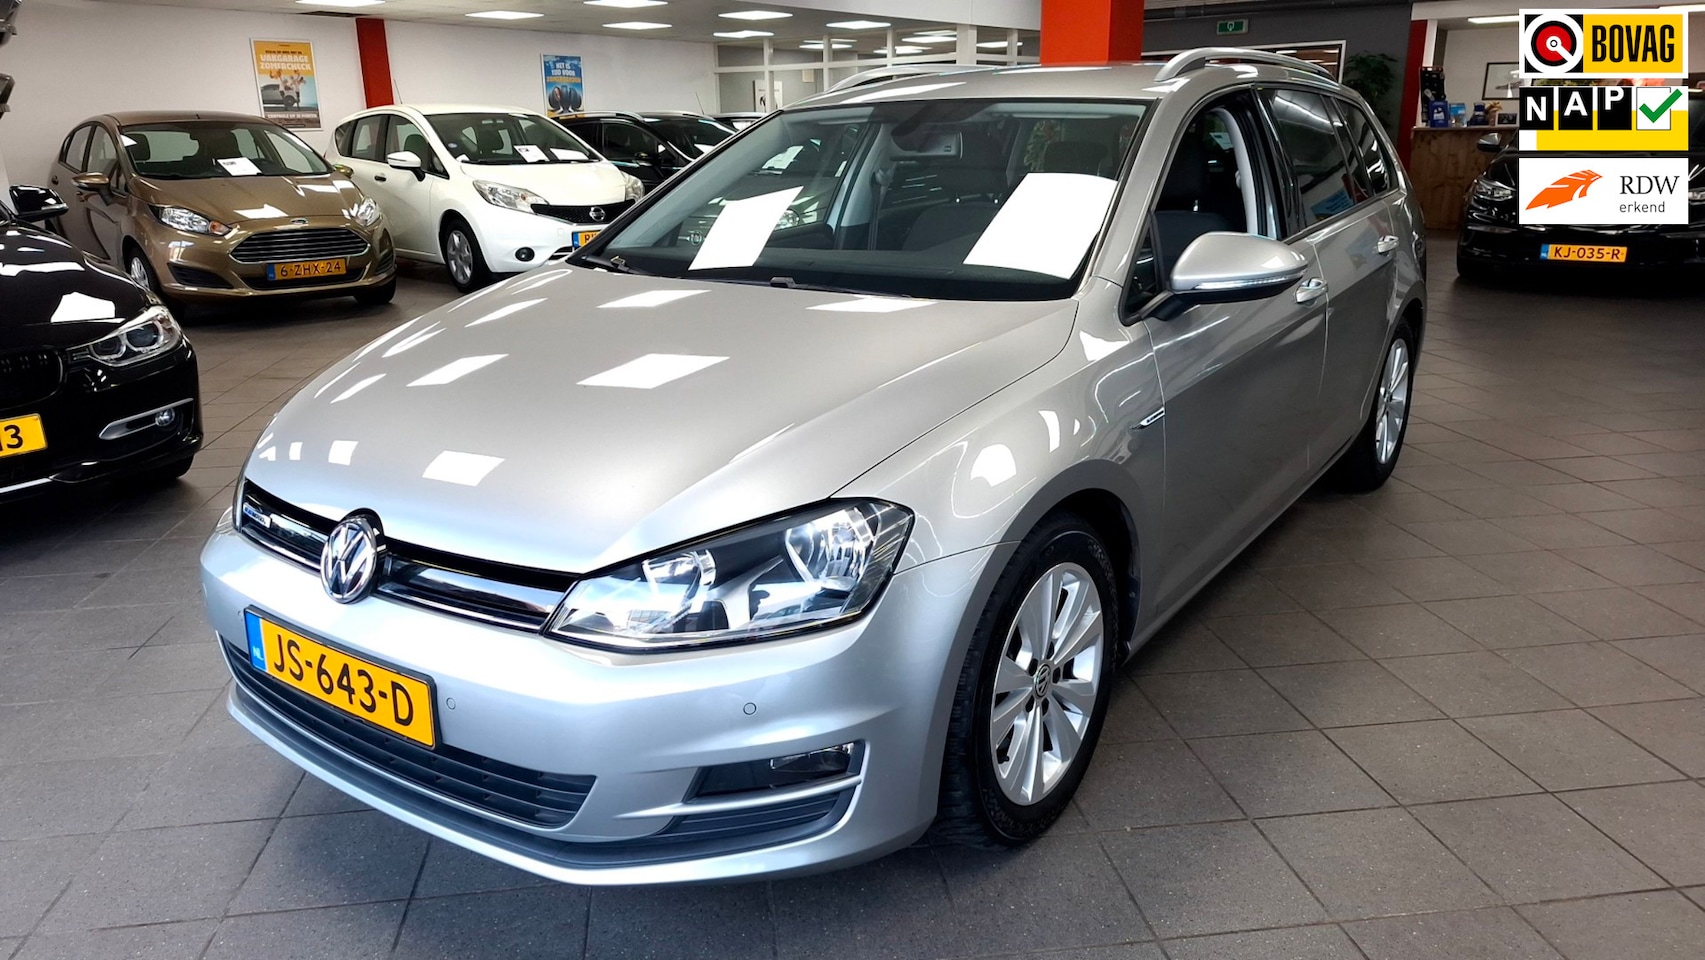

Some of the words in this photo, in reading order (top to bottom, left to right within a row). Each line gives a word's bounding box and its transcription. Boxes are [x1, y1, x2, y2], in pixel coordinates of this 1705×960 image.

[1554, 246, 1621, 260] KJ-035-R
[280, 261, 341, 277] 6-ZHX-24
[273, 634, 414, 727] JS-643-D
